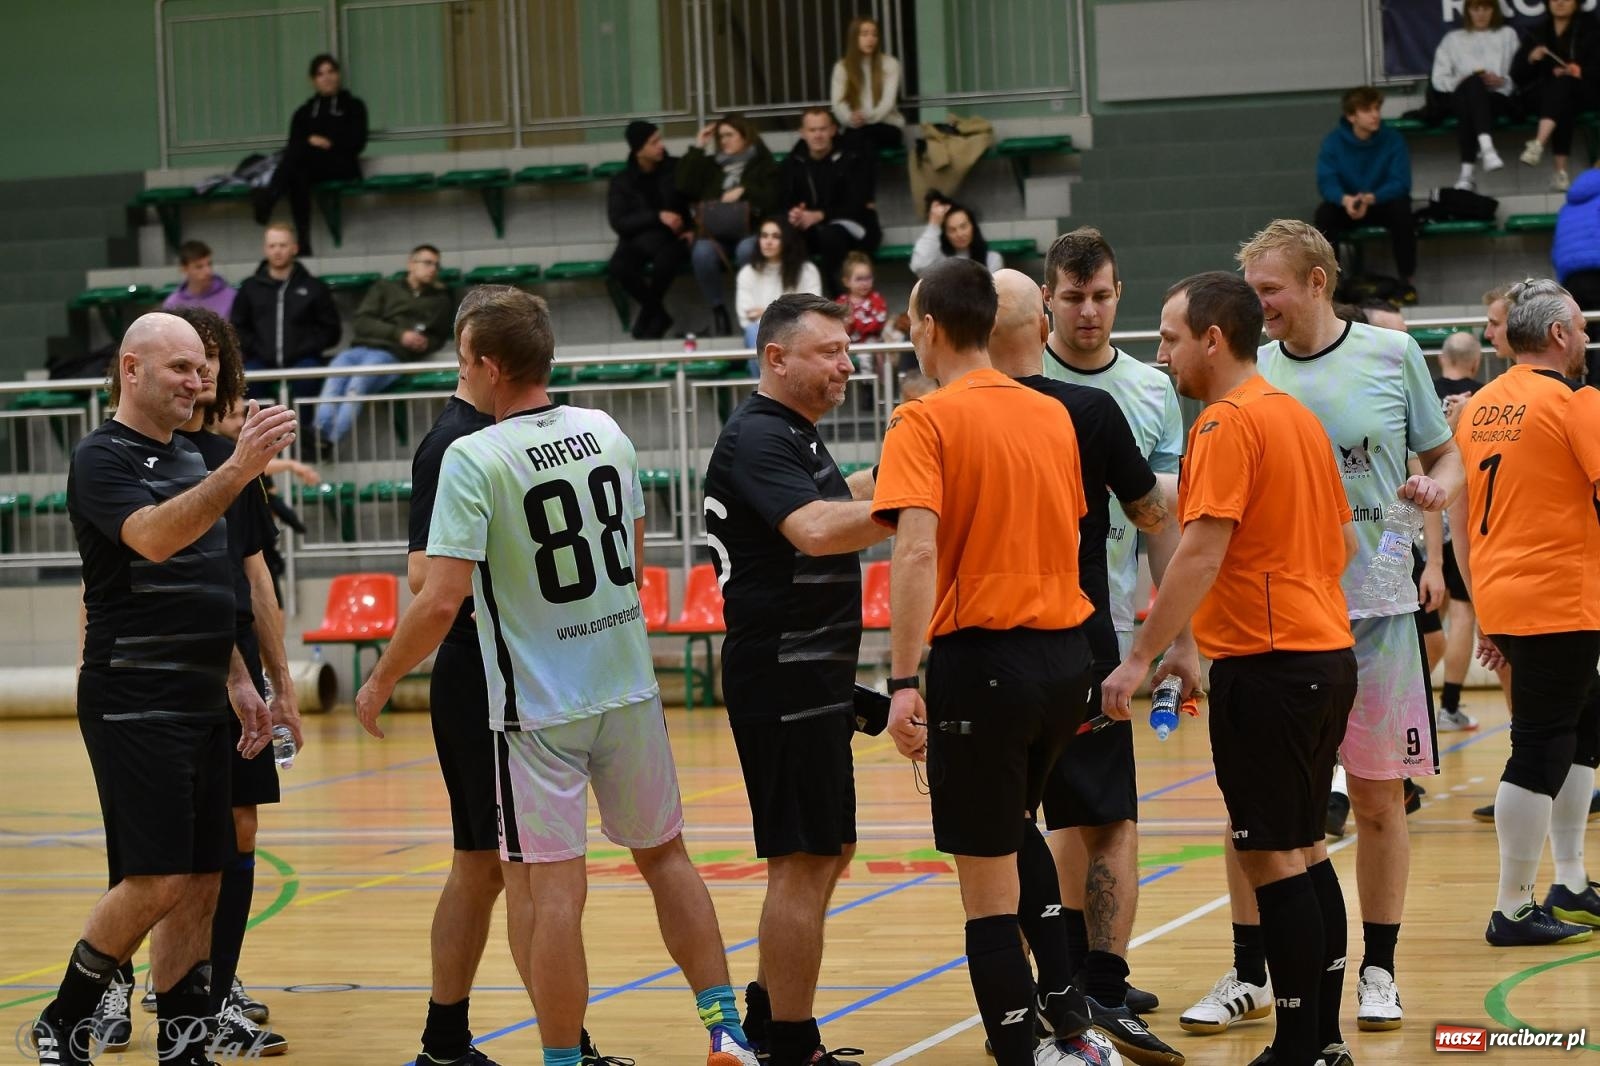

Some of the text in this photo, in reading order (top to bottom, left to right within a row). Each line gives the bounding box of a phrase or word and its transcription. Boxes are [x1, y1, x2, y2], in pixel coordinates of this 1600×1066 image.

[1472, 404, 1527, 427] ODRA
[525, 431, 602, 472] RAFCIO
[1470, 427, 1522, 443] RACIBÓRZ
[1479, 453, 1502, 536] 1
[522, 464, 636, 604] 88
[1406, 727, 1421, 756] 9
